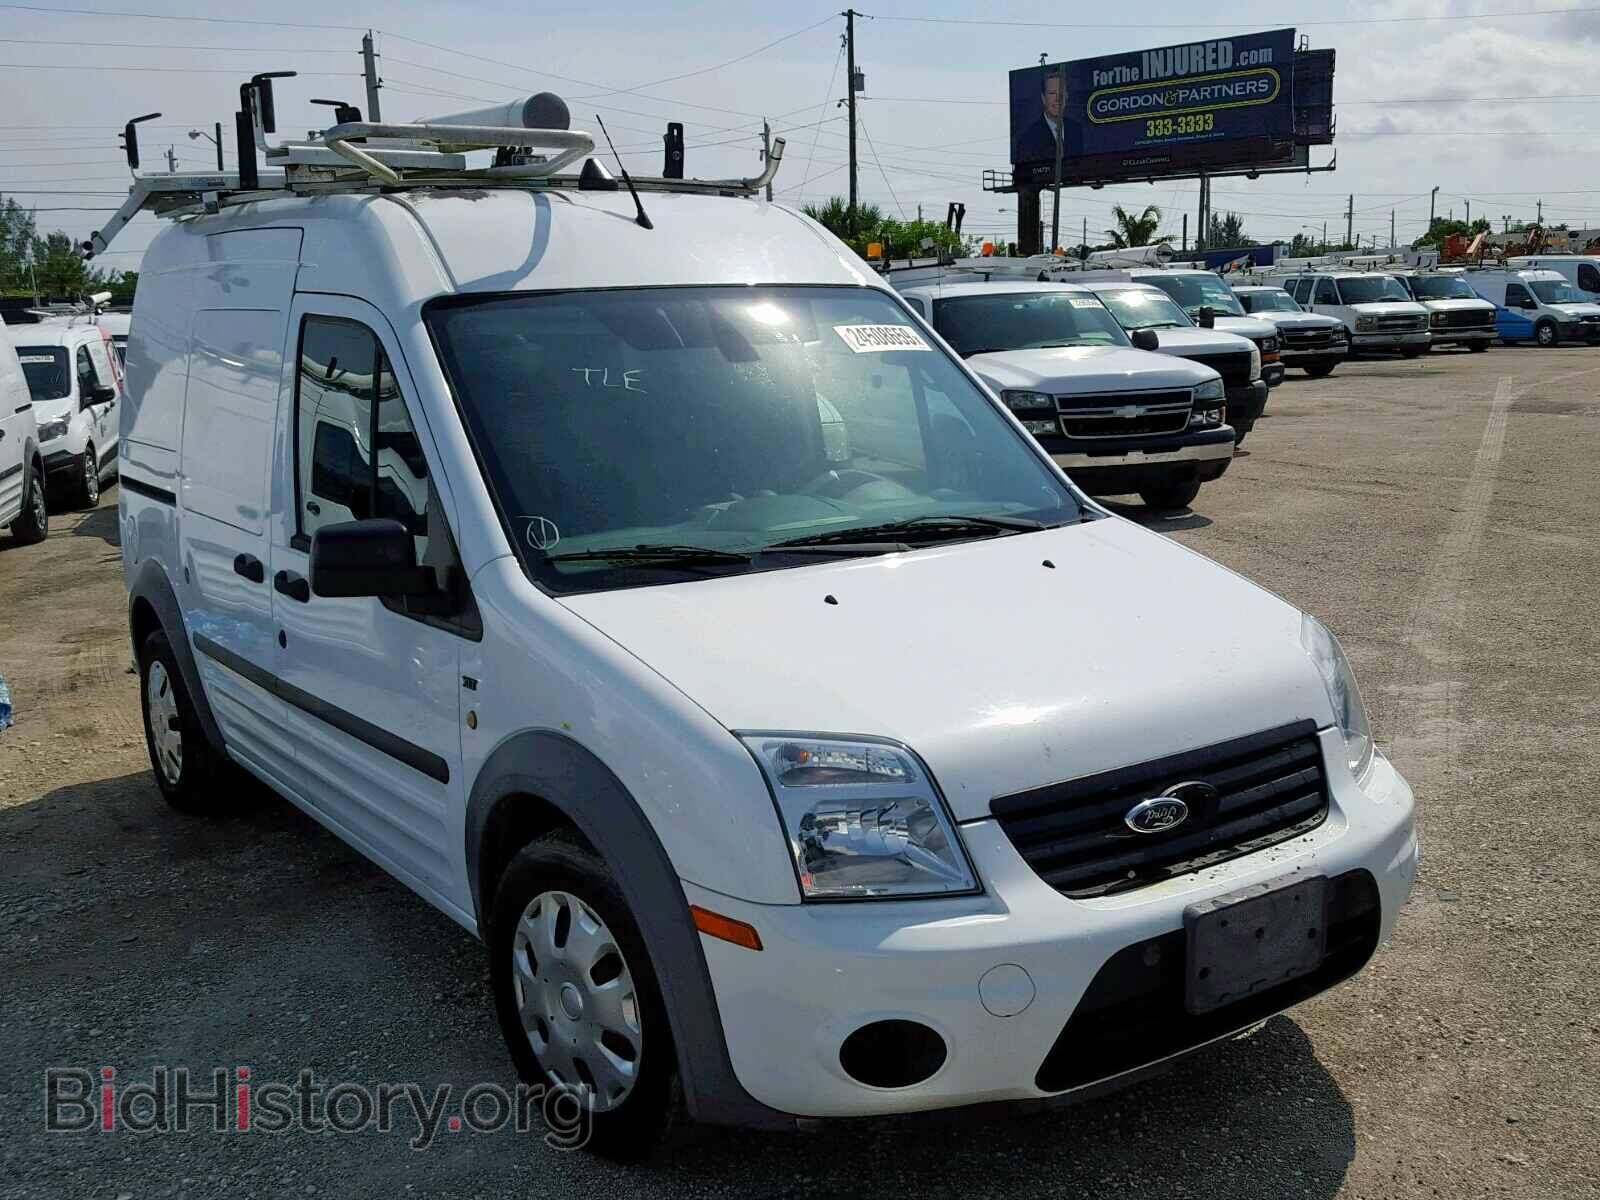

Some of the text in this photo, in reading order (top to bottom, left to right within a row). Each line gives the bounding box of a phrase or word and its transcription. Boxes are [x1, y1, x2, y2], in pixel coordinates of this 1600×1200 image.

[1093, 66, 1140, 87] ForThe
[1142, 41, 1233, 80] INJURED
[1146, 113, 1214, 137] 333-3333
[570, 367, 648, 394] TLE
